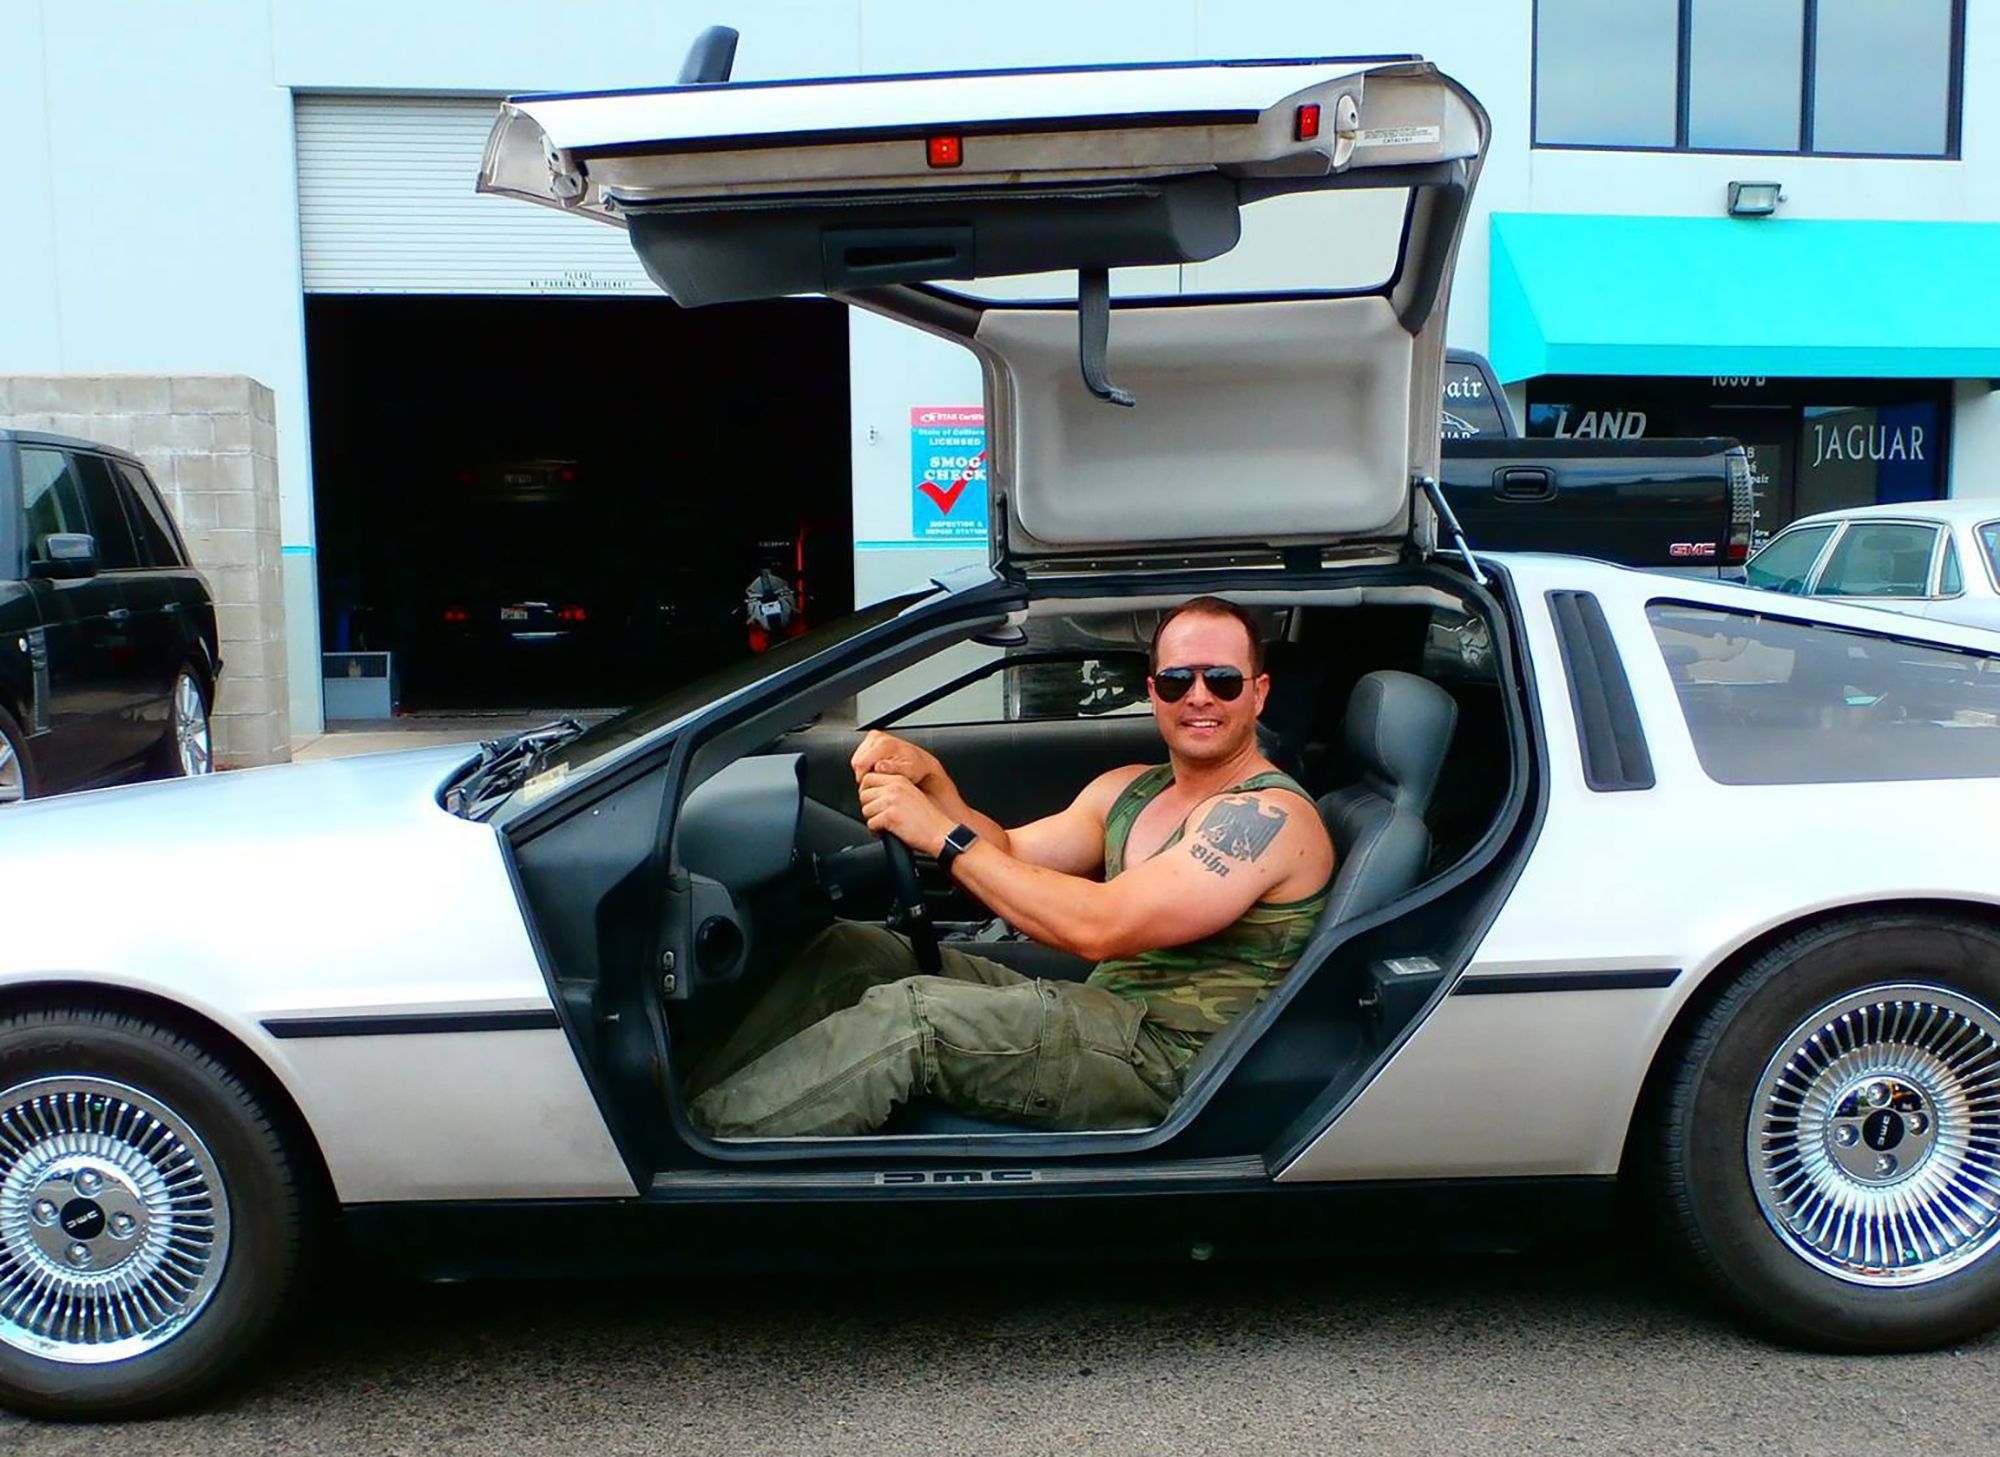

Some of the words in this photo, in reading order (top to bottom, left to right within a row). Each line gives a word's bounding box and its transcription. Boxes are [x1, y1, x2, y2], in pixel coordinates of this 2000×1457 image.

[565, 271, 592, 280] PLEASE
[544, 281, 576, 289] PARKING
[1441, 376, 1482, 398] air
[1554, 410, 1647, 439] LAND
[918, 428, 941, 436] State
[929, 437, 981, 446] LICENSED
[1812, 424, 1924, 468] JAGUAR
[924, 469, 987, 481] CHECK
[1669, 543, 1716, 556] GMC
[883, 1170, 1034, 1185] DMC
